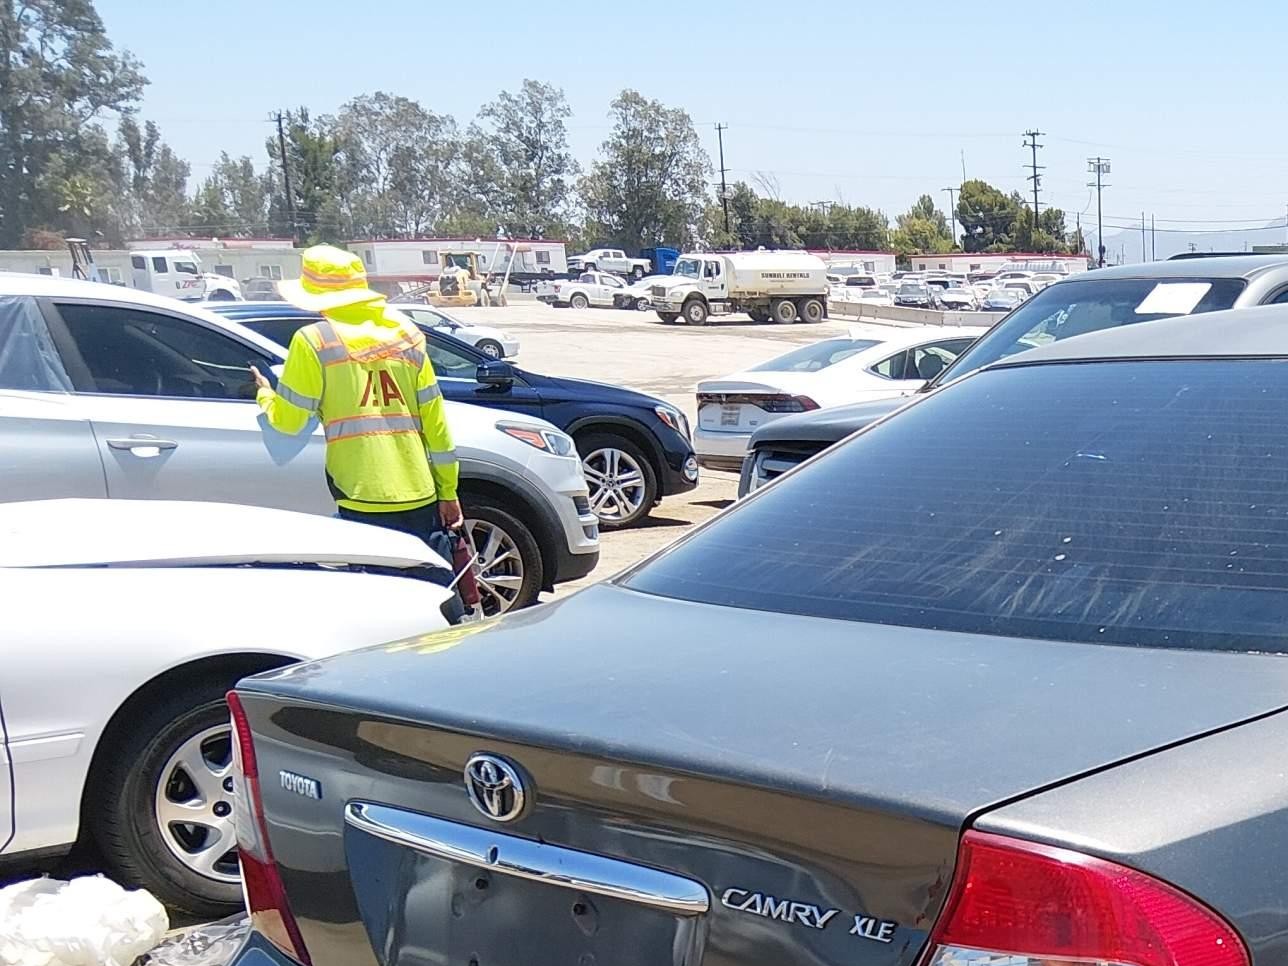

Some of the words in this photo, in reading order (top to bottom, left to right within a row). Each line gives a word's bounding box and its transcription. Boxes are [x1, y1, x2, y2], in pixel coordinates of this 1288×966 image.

[279, 770, 318, 800] TOYOTA
[721, 888, 840, 929] CAMRY
[849, 914, 895, 943] XLE
